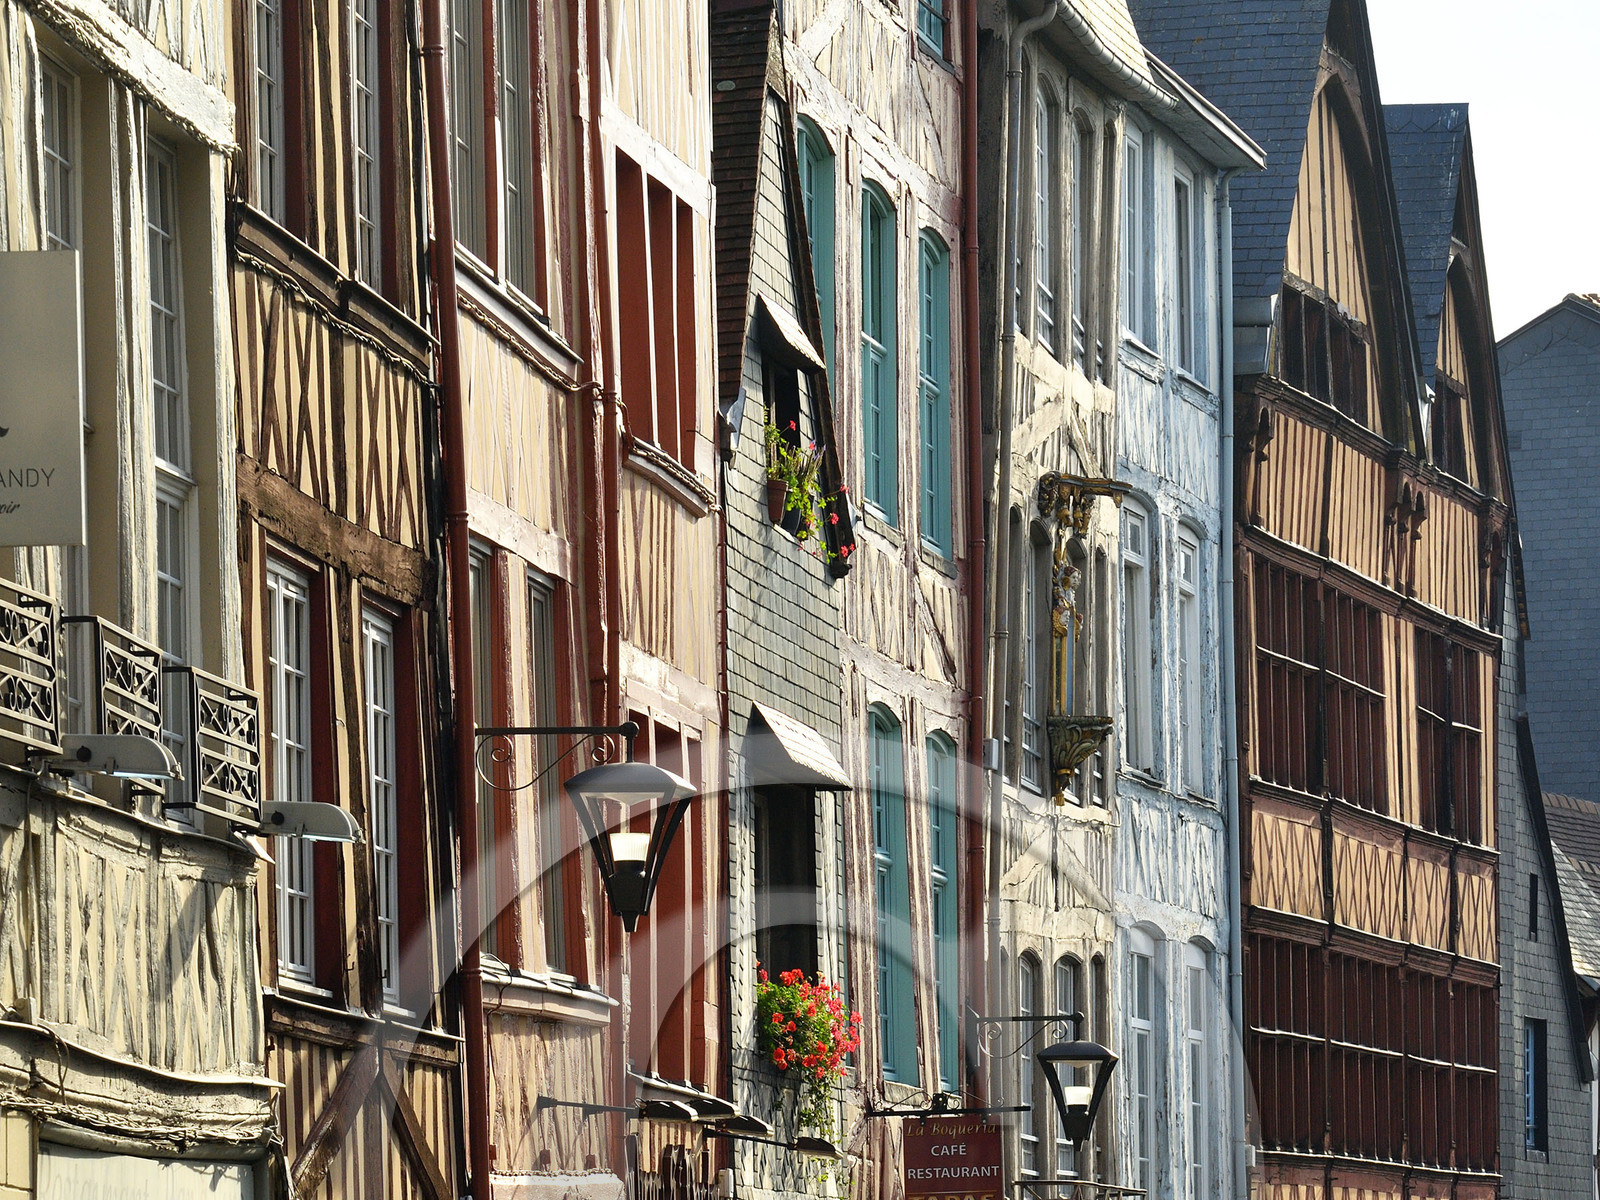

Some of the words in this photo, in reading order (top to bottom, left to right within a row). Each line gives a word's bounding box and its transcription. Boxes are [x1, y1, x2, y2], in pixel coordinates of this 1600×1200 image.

[906, 1123, 924, 1137] La
[930, 1122, 996, 1140] Boqueria
[931, 1142, 967, 1156] CAFÉ
[907, 1165, 1000, 1179] RESTAURANT
